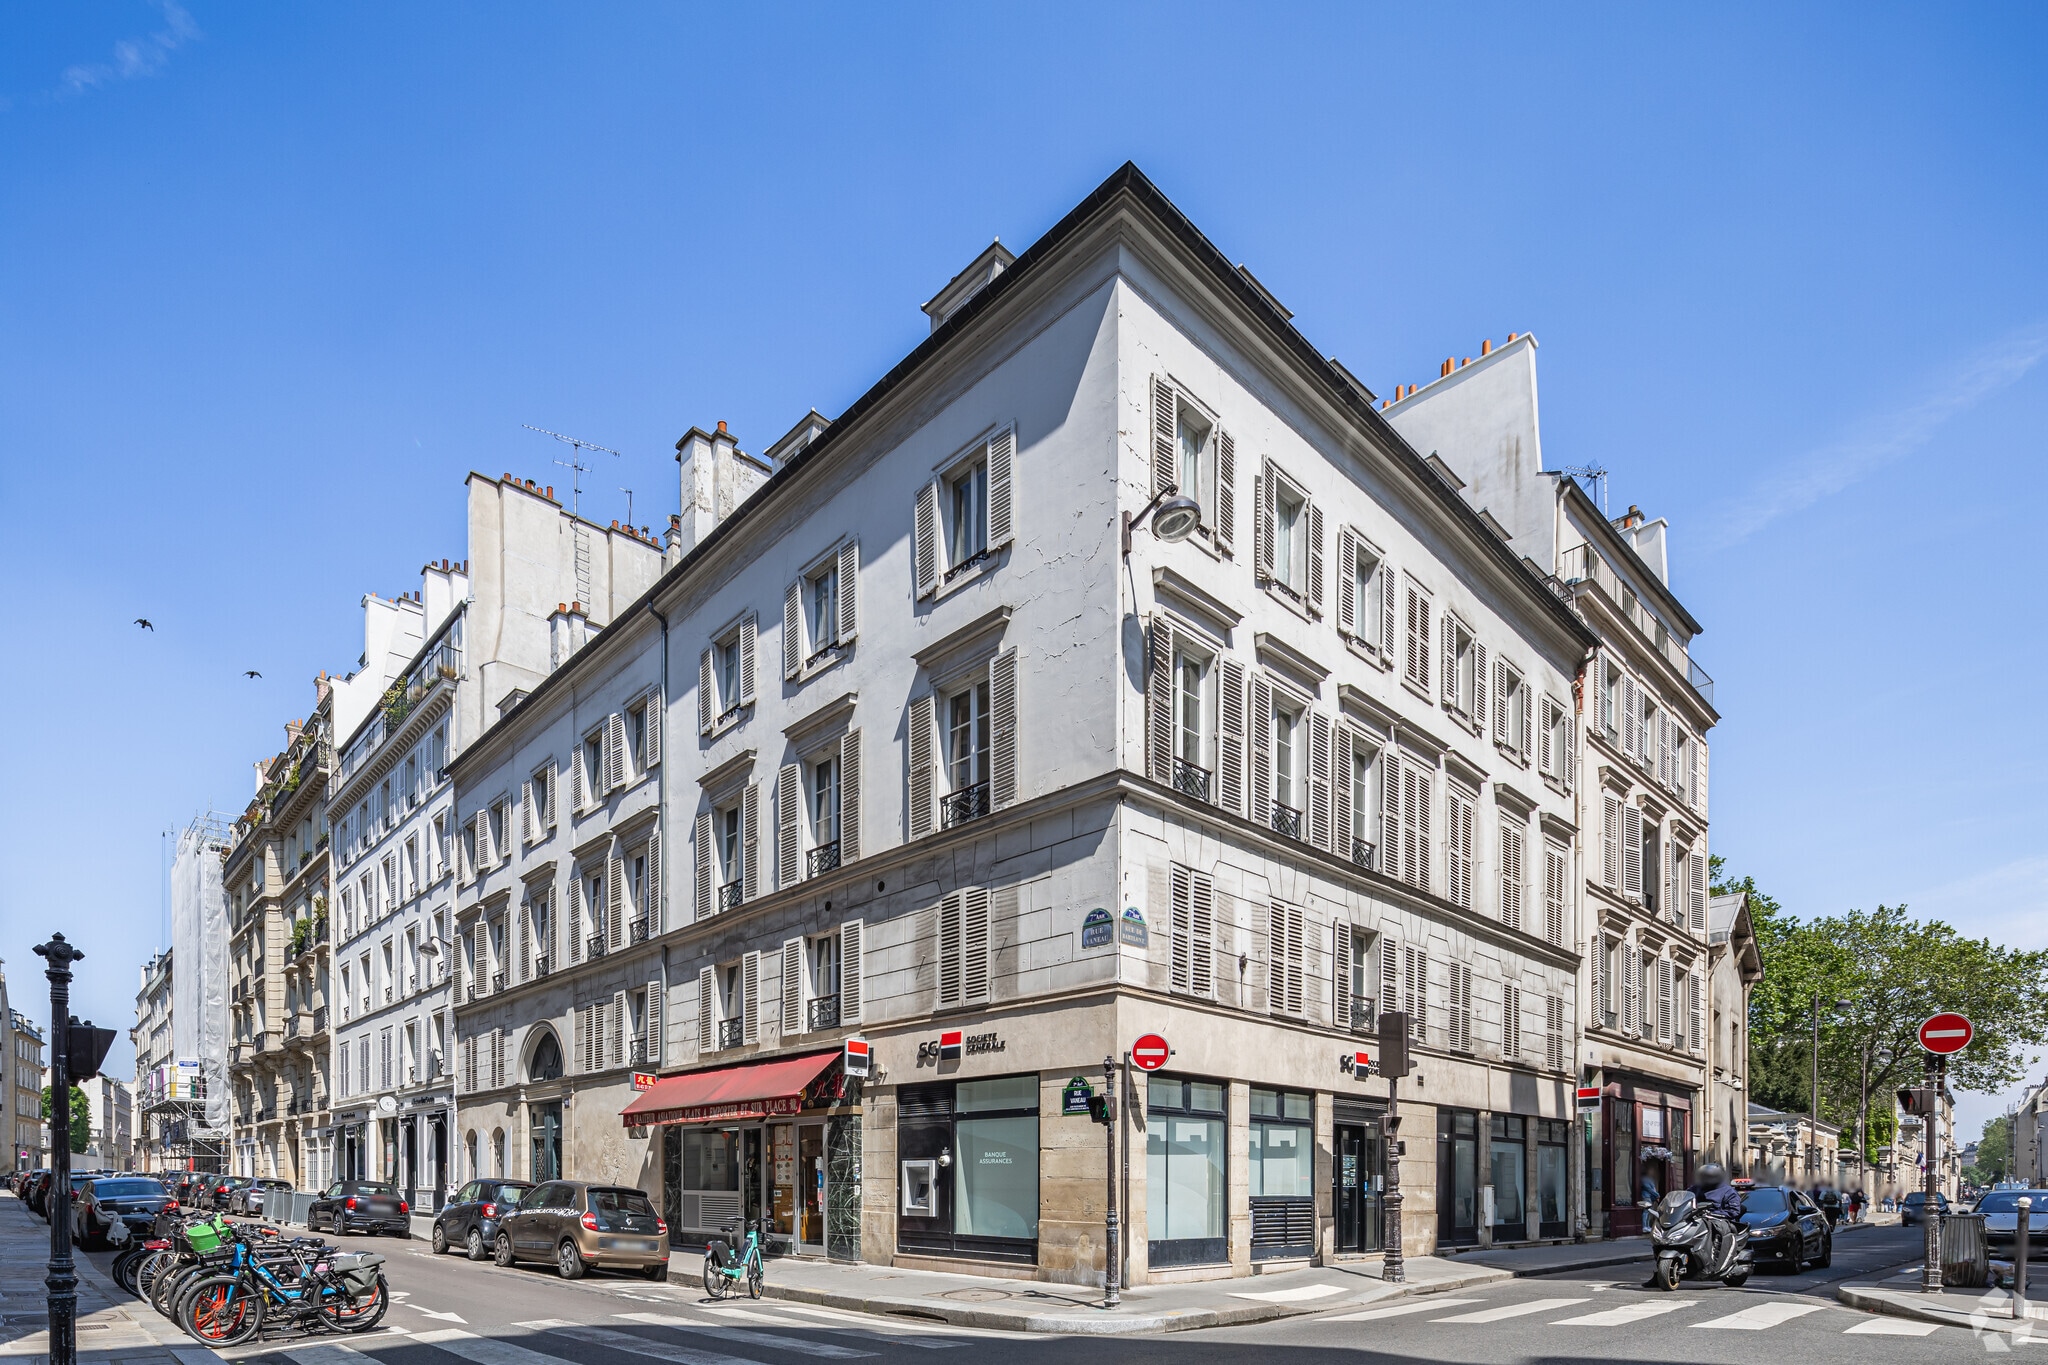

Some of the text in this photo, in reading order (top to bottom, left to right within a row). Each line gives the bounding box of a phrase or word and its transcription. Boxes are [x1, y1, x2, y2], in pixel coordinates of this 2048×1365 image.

[1090, 927, 1104, 936] RUE
[1086, 935, 1108, 945] VANEAU
[919, 1041, 938, 1058] SG
[684, 1107, 701, 1119] PLATS
[709, 1103, 738, 1117] EMPORTER
[740, 1102, 748, 1114] ET
[750, 1100, 763, 1113] SUR
[765, 1099, 787, 1112] PLACE
